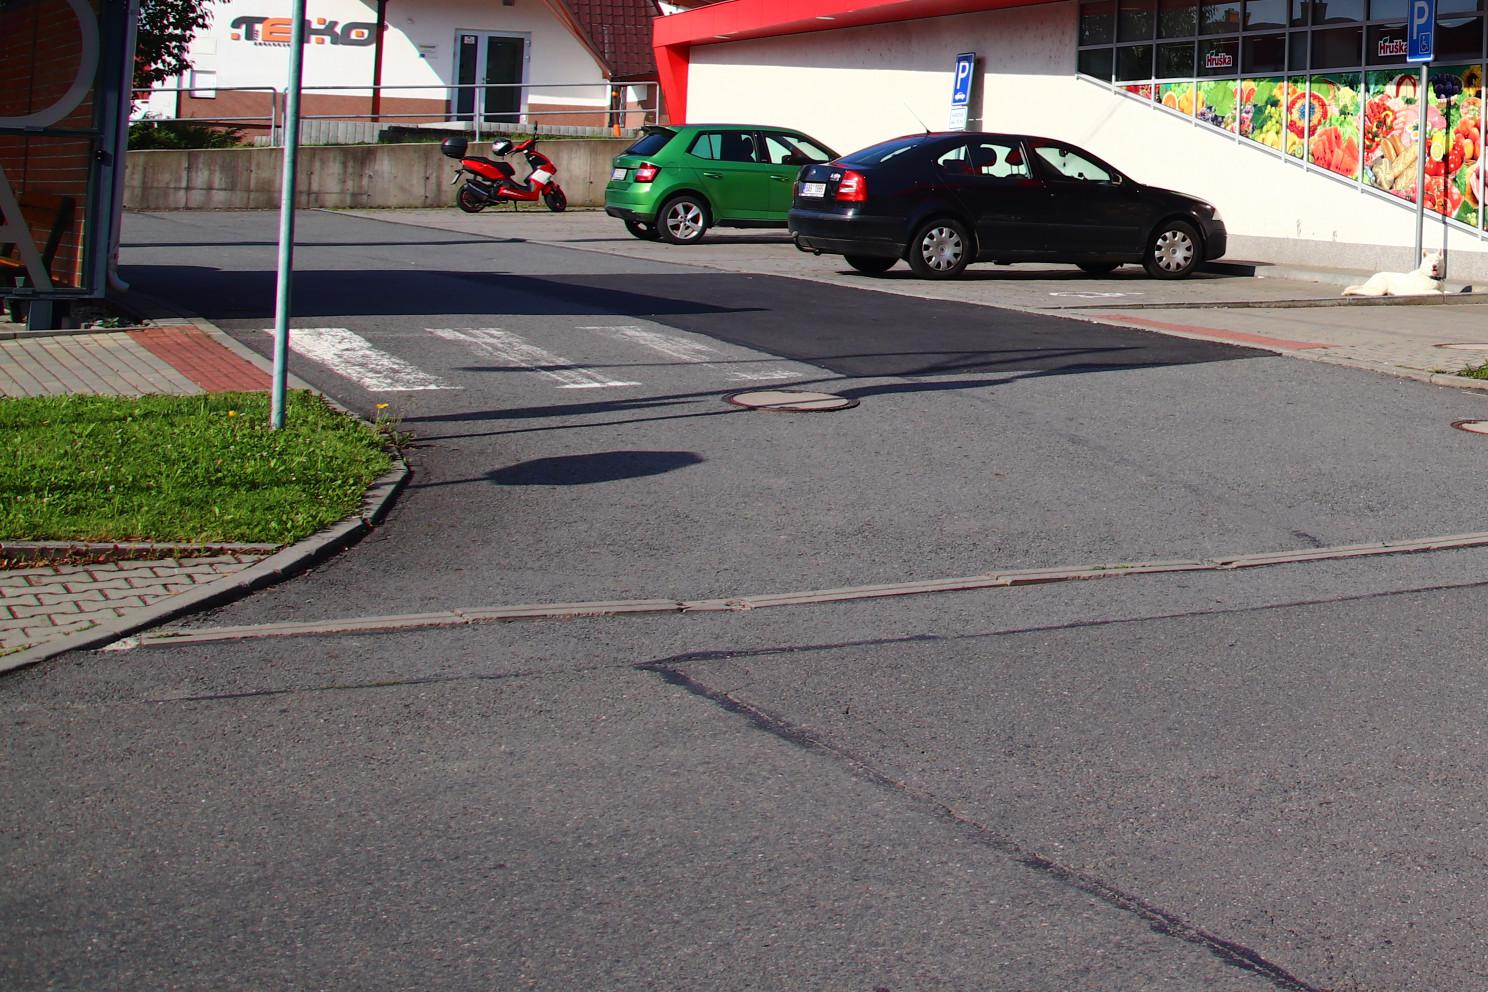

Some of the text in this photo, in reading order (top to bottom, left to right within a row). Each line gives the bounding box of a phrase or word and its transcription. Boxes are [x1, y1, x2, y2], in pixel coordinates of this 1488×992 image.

[231, 16, 377, 46] TEKO
[1413, 1, 1429, 40] P
[1207, 53, 1232, 66] Hruška
[956, 61, 970, 90] P
